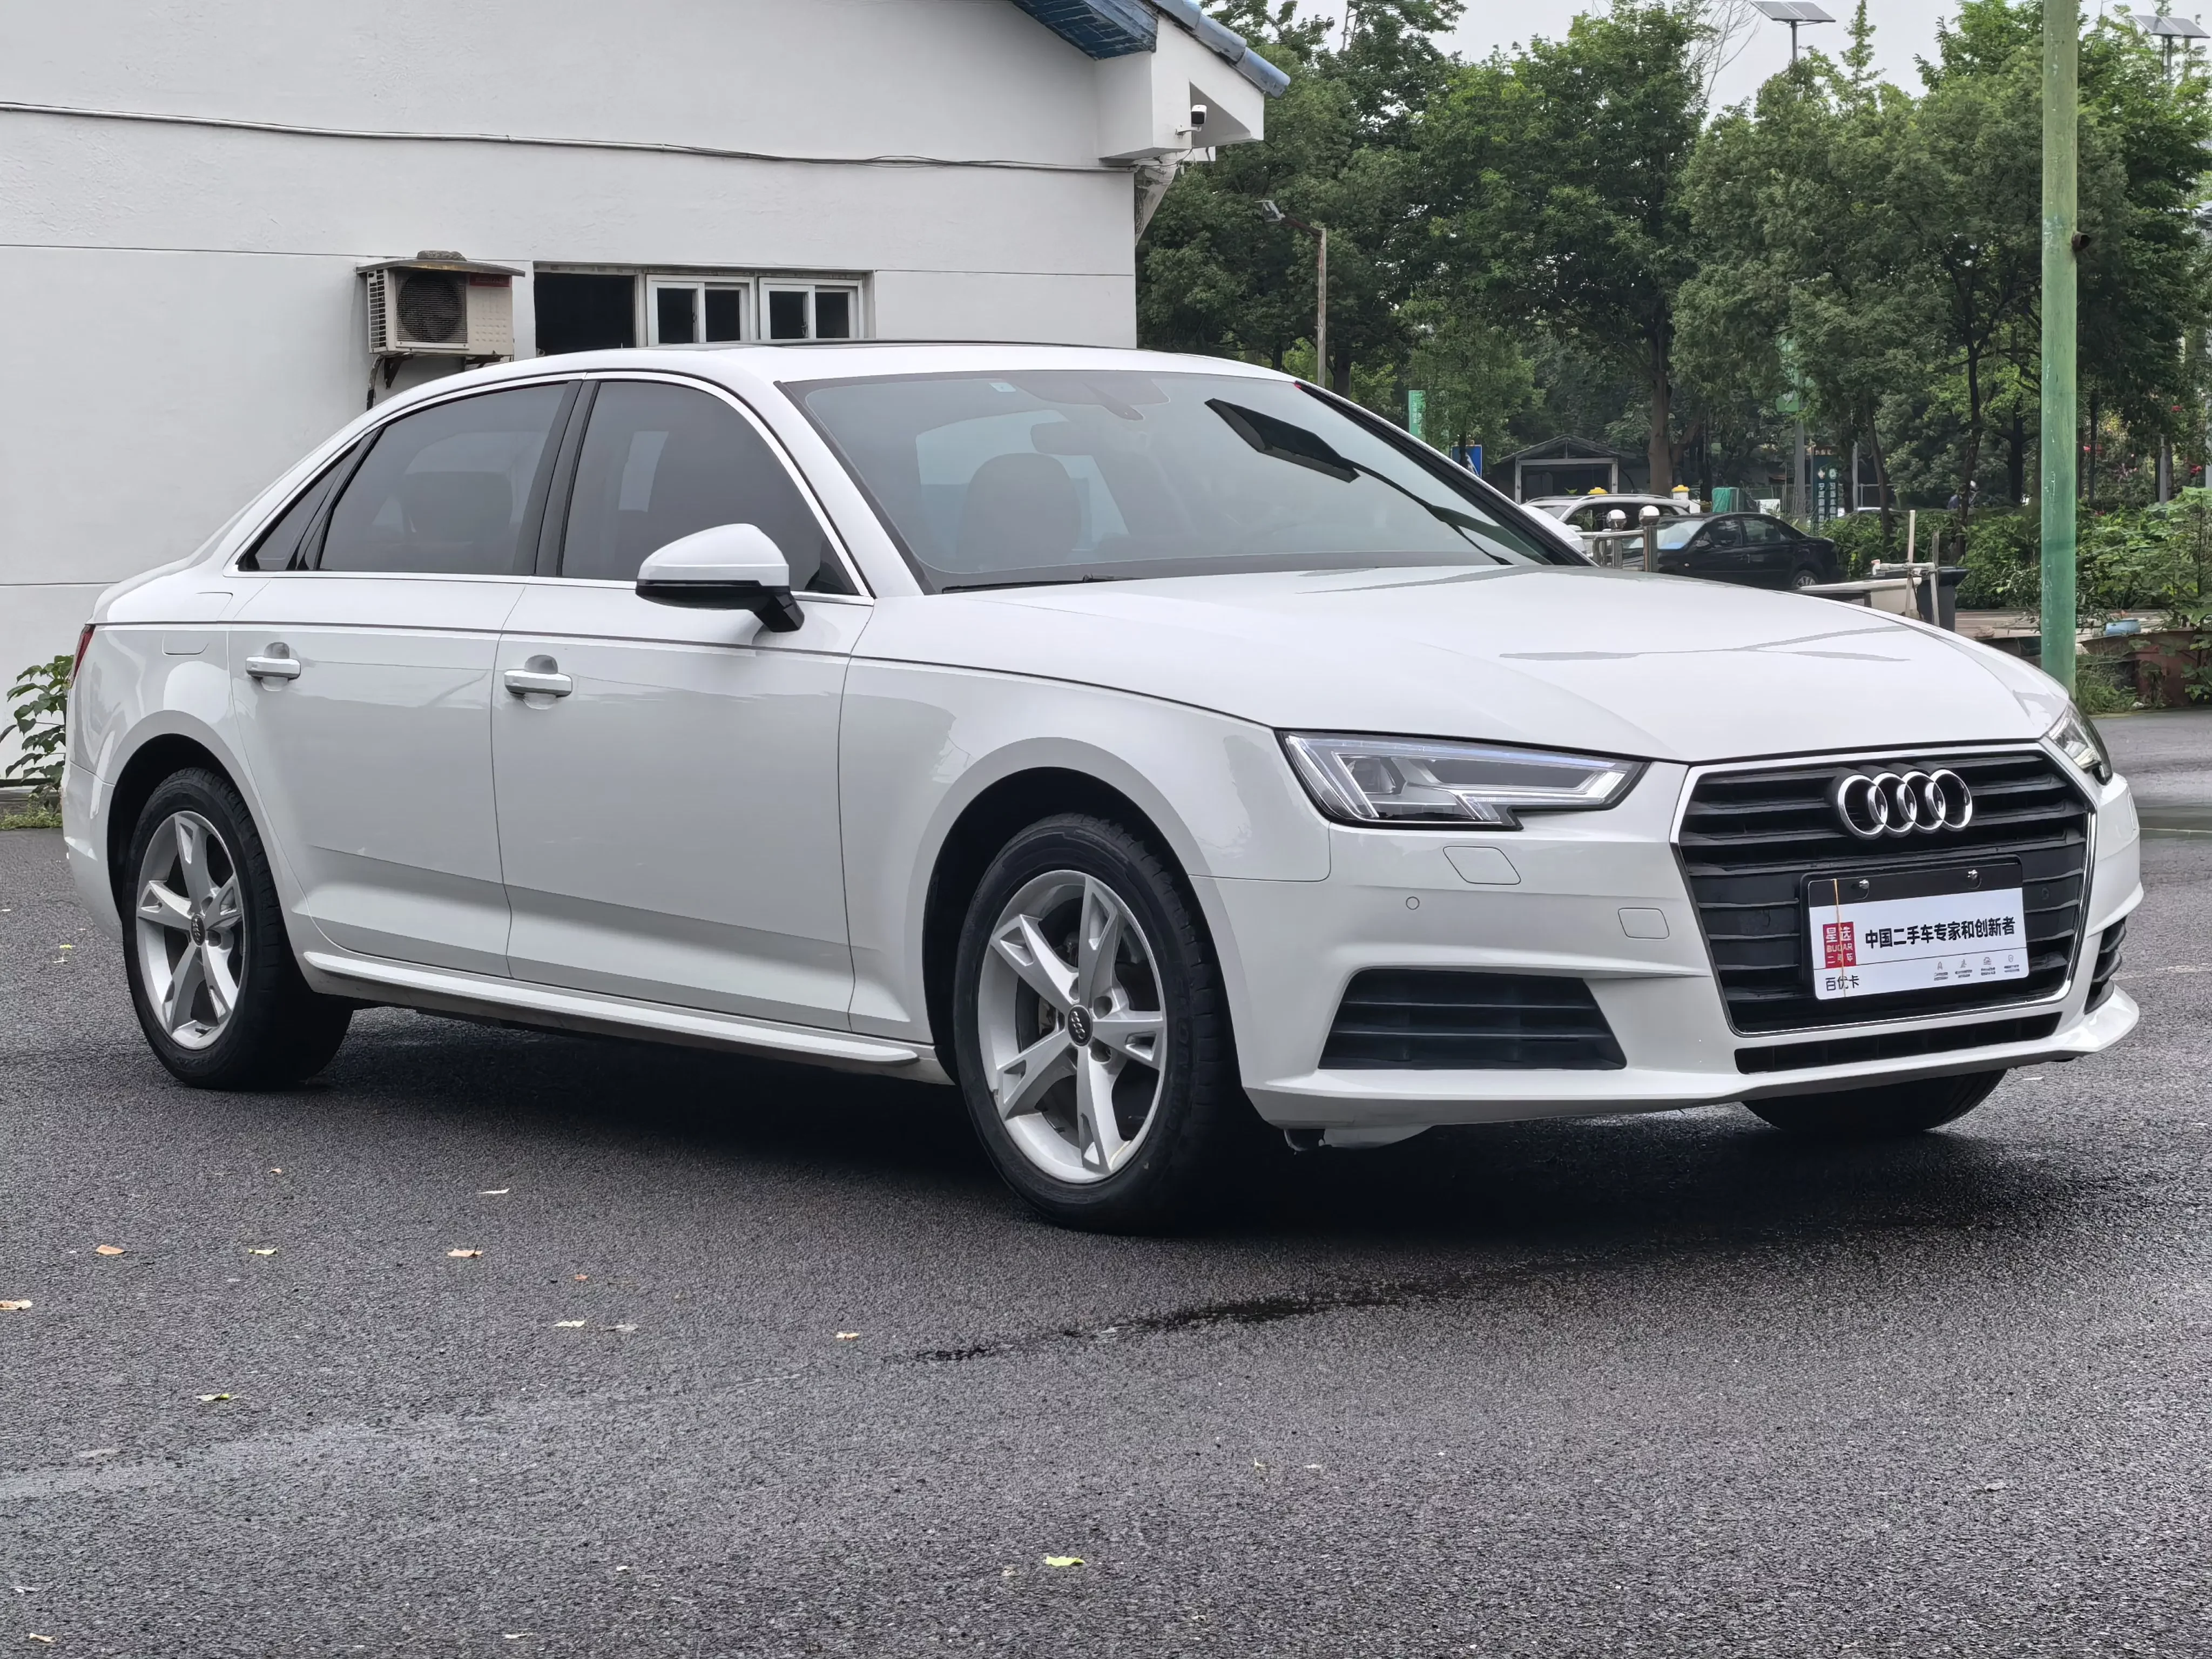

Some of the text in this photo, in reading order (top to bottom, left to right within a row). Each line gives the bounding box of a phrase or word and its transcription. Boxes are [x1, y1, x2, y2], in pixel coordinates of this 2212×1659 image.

[1865, 916, 2015, 949] 中国二手车专家和创新者
[1825, 975, 1859, 992] 百优卡
